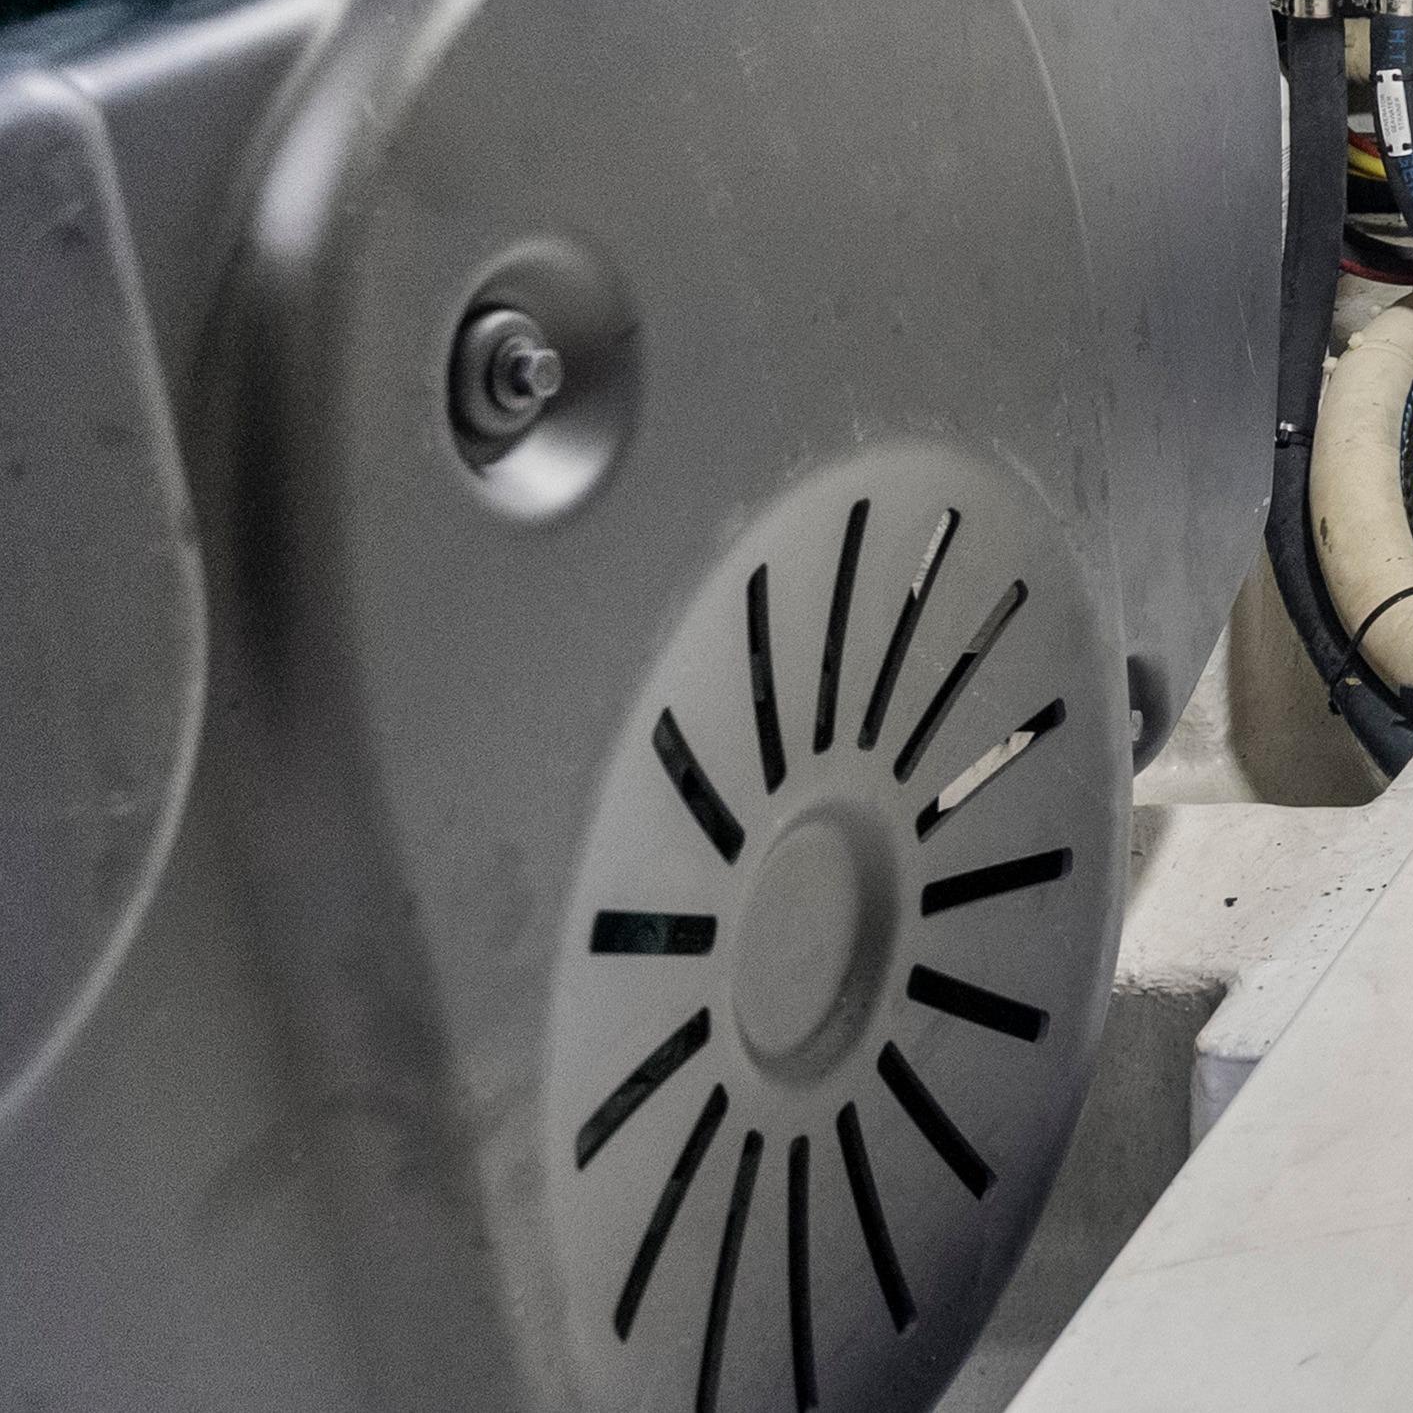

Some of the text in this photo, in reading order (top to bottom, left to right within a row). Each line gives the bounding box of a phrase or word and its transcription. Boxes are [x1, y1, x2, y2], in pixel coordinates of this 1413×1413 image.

[1380, 93, 1391, 136] GENERATOR
[1386, 96, 1397, 133] SEAWATER
[1394, 97, 1405, 131] STRAINER
